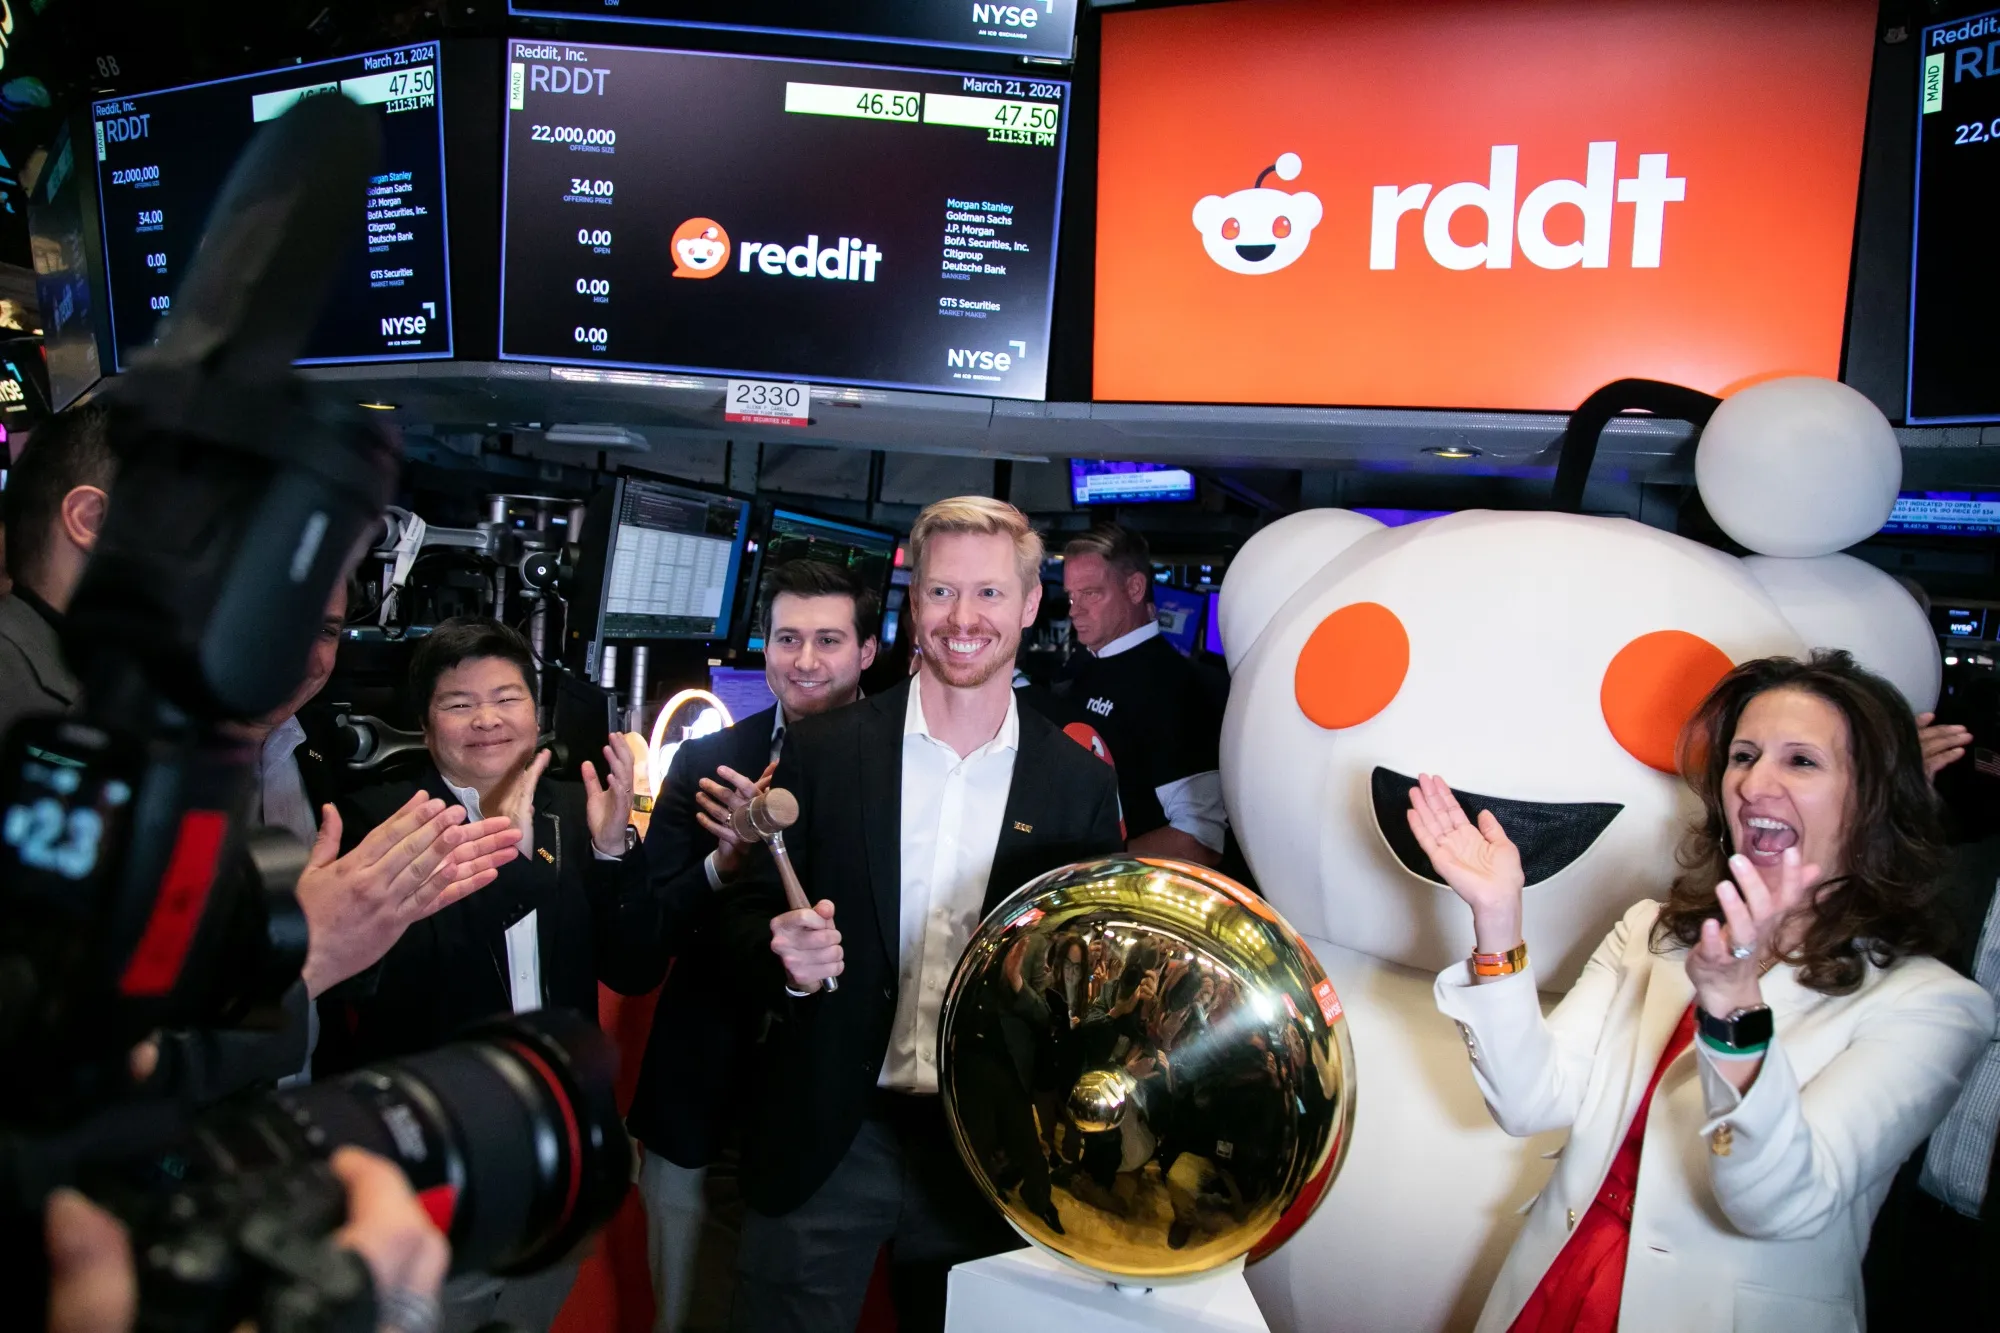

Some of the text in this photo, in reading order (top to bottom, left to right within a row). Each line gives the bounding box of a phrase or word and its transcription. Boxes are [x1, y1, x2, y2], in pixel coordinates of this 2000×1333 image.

[364, 46, 434, 70] March 21, 2024
[515, 44, 588, 61] Reddit, Inc.
[389, 70, 434, 96] 47.50
[513, 71, 522, 100] MAND
[530, 64, 611, 96] RDDT
[1927, 65, 1940, 102] MAND
[963, 78, 1061, 99] March 21, 2024
[96, 101, 136, 116] Reddit, Inc.
[386, 94, 434, 114] 1:11:31 PM
[856, 92, 919, 117] 46.50
[994, 104, 1057, 129] 47.50
[106, 113, 150, 143] RDDT
[531, 125, 616, 145] 22,000,000
[987, 129, 1054, 147] 1:11:31 PM
[569, 144, 615, 154] OFFERING SIZE
[112, 165, 159, 184] 22,000,000
[389, 171, 412, 181] Stanley
[394, 183, 412, 193] Sachs
[571, 178, 614, 196] 34.00
[378, 198, 401, 207] Morgan
[563, 195, 593, 203] OFFERING
[947, 198, 1014, 214] Morgan Stanley
[1369, 140, 1686, 270] rddt
[138, 210, 163, 225] 34.00
[367, 206, 427, 220] BofA Securities, Inc.
[946, 211, 1012, 225] Goldman Sachs
[368, 222, 396, 232] Citigroup
[945, 223, 995, 237] J.P. Morgan
[368, 231, 413, 244] Deutsche Bank
[578, 229, 612, 246] 0.00
[944, 236, 1029, 252] BofA Securities, Inc.
[147, 253, 167, 267] 0.00
[739, 234, 882, 282] reddit
[943, 248, 983, 261] Citigroup
[370, 268, 413, 279] GTS Securities
[942, 260, 1006, 275] Deutsche Bank
[941, 272, 971, 280] BANKERS
[576, 278, 610, 295] 0.00
[151, 296, 170, 310] 0.00
[939, 297, 1001, 311] GTS Securities
[939, 309, 986, 319] MARKET MAKER
[575, 326, 608, 343] 0.00
[736, 384, 800, 407] 2330
[1086, 696, 1114, 716] rddt
